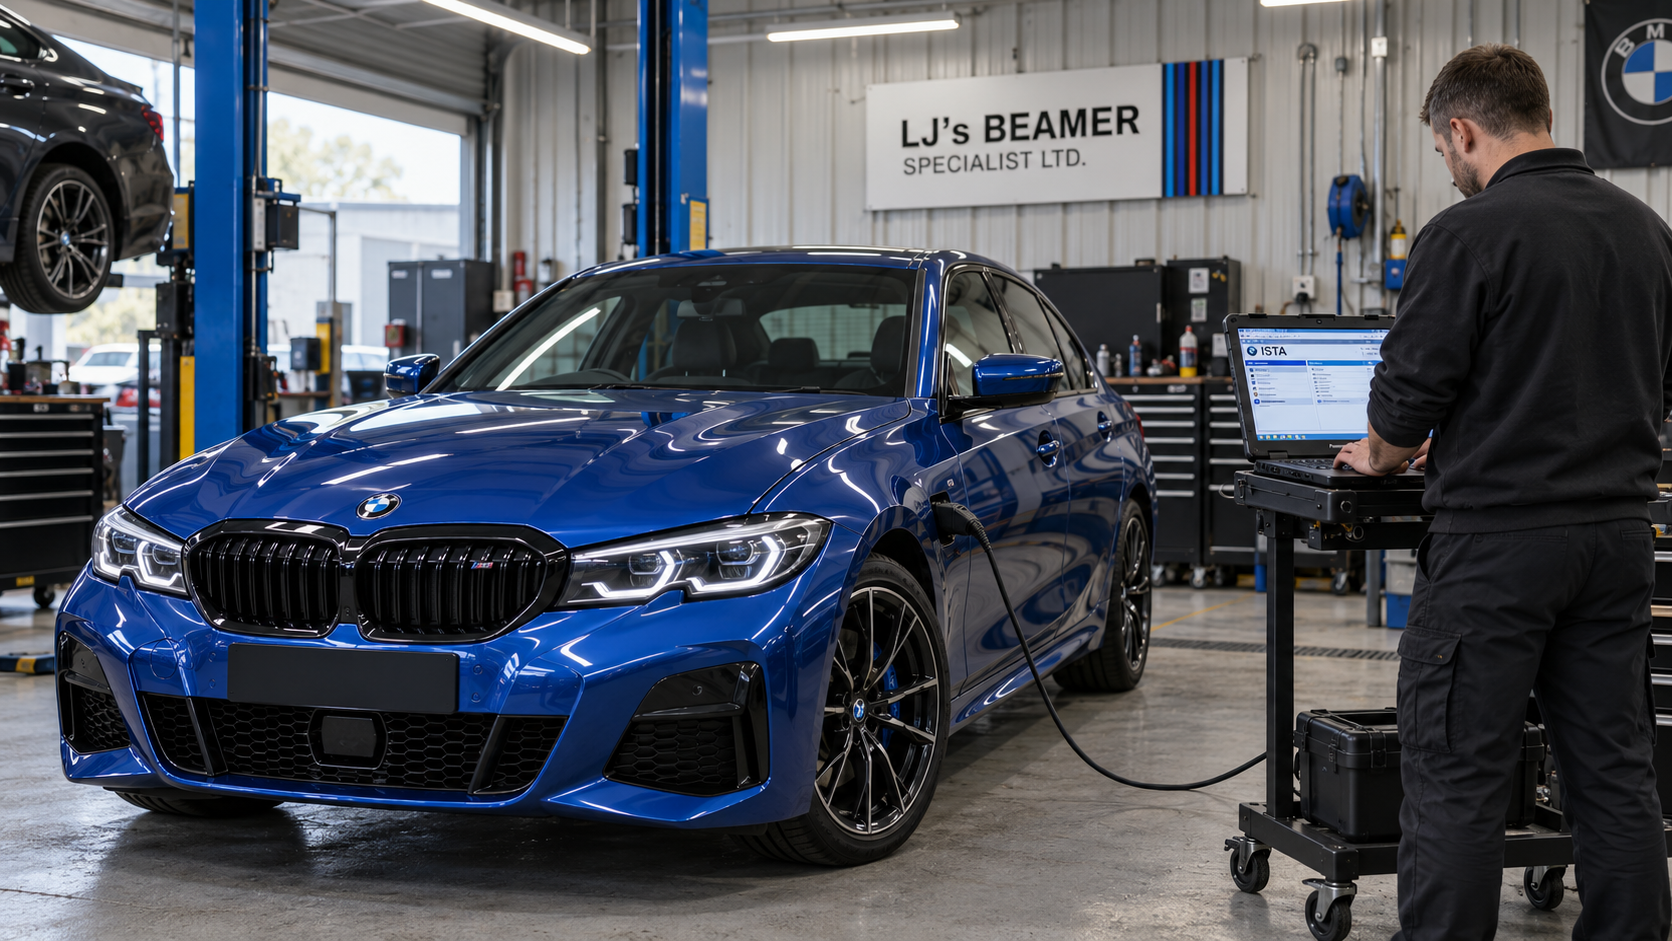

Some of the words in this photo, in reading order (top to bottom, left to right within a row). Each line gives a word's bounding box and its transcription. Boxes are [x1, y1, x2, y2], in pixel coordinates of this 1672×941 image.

[1614, 23, 1665, 58] BM
[902, 116, 970, 148] LJ’s
[984, 104, 1140, 144] BEAMER
[903, 151, 1032, 175] SPECIALIST
[1041, 148, 1086, 169] LTD.
[1261, 346, 1287, 356] ISTA
